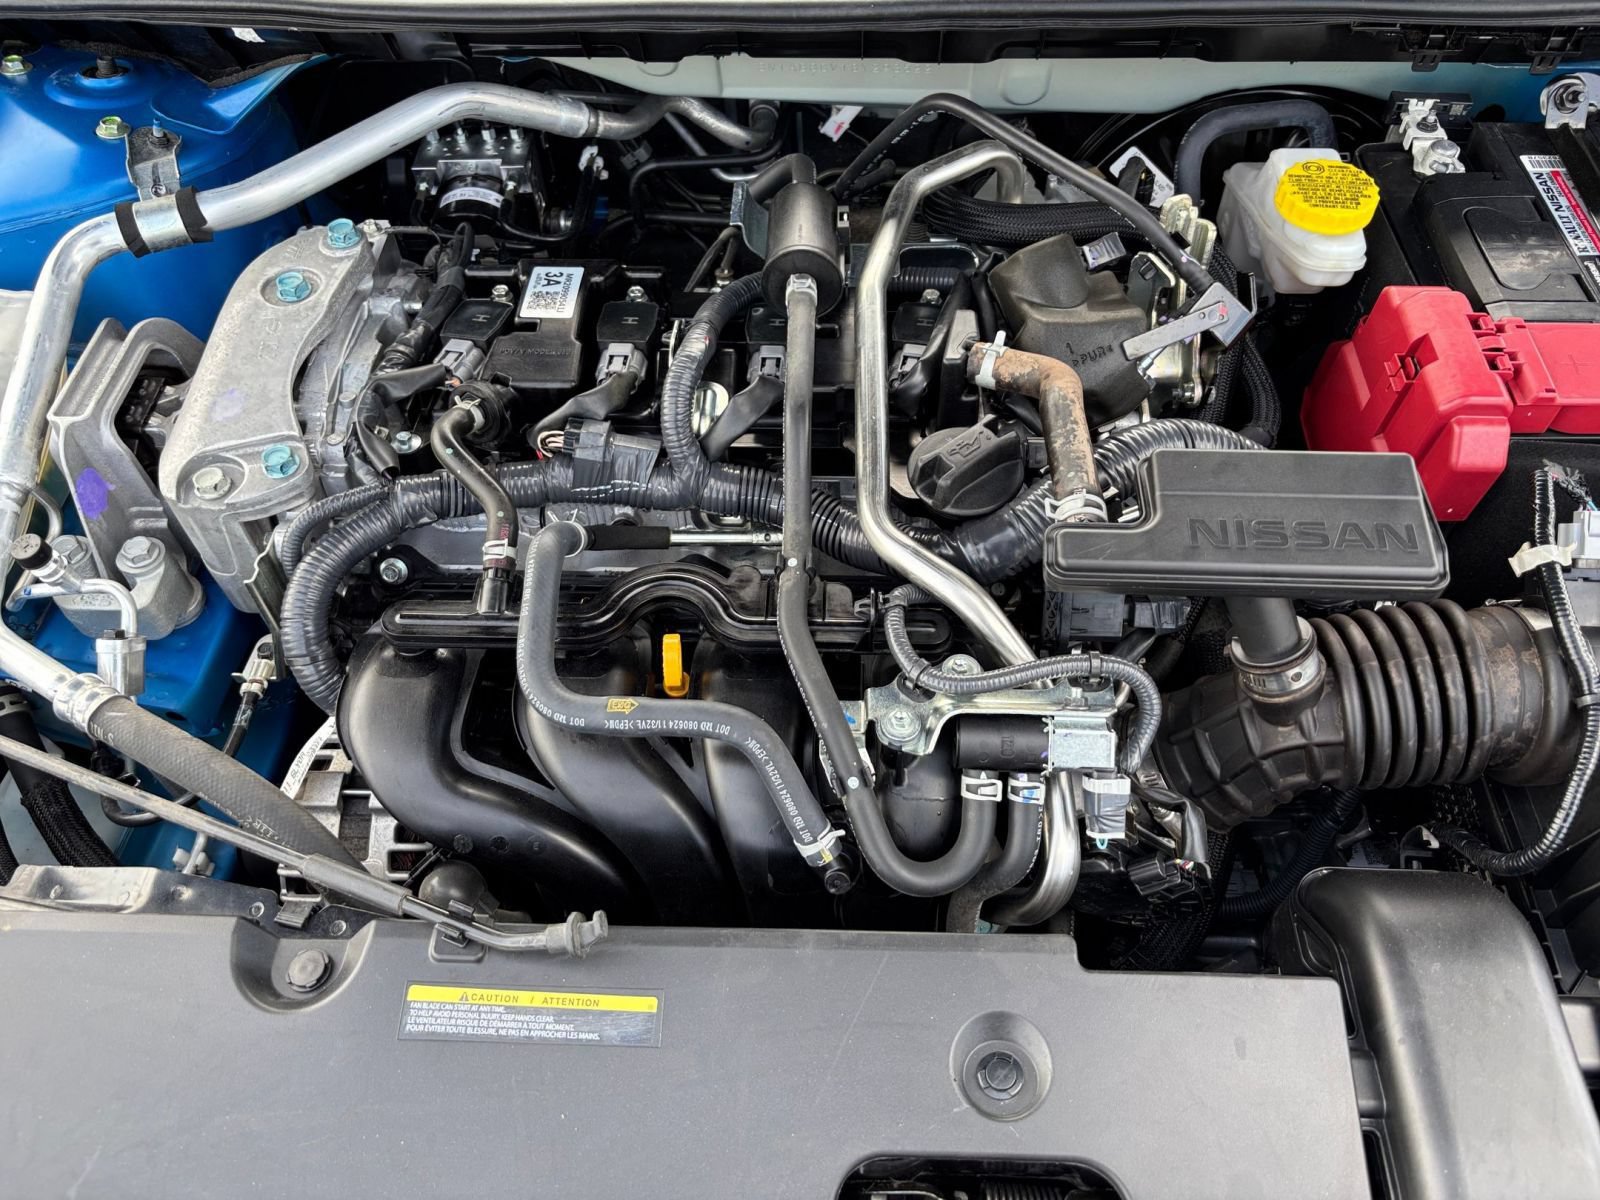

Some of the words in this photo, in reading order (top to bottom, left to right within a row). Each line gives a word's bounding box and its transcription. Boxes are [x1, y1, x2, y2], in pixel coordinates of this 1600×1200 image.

[1533, 172, 1565, 212] NISSAN
[542, 272, 564, 287] 3A
[1188, 518, 1418, 552] NISSAN
[569, 718, 585, 726] DOT
[669, 720, 698, 730] 080624
[715, 723, 731, 735] DOT
[779, 789, 799, 816] 080624
[800, 829, 813, 842] DOT
[471, 993, 519, 1003] CAUTION
[542, 997, 600, 1007] ATTENTION
[454, 1003, 471, 1011] START
[446, 1026, 465, 1034] TOUTE
[530, 1030, 566, 1038] APPROCHER
[579, 1032, 600, 1040] MAINS.
[546, 1023, 574, 1031] MOMENT.
